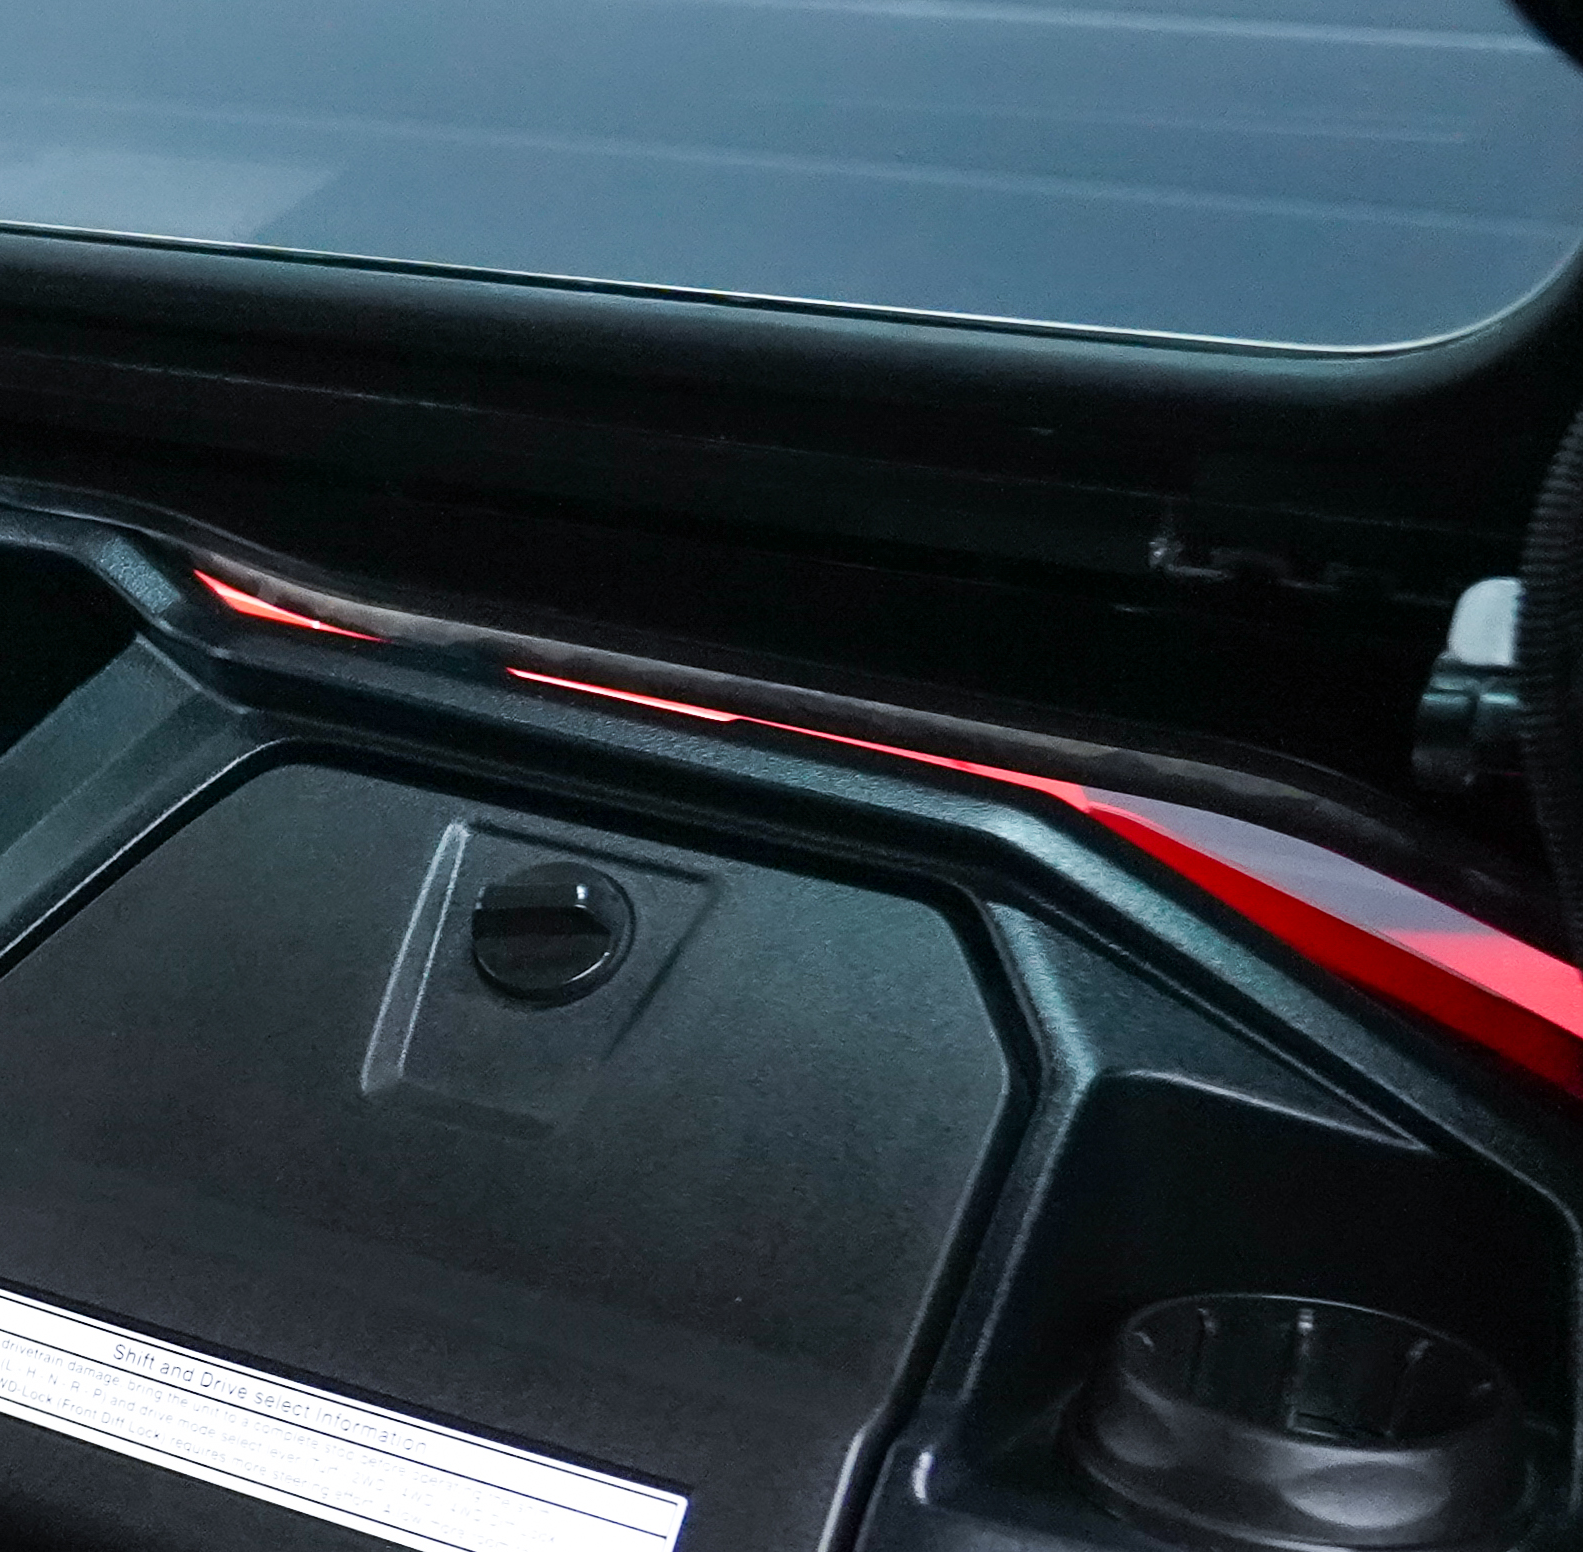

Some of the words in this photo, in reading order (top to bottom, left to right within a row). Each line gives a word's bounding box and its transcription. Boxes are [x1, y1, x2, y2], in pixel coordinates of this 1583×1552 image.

[0, 1338, 63, 1366] drivetrain
[126, 1378, 163, 1403] bring
[166, 1391, 188, 1408] the
[223, 1409, 237, 1424] to
[25, 1365, 37, 1378] H
[47, 1372, 58, 1385] N
[69, 1379, 81, 1392] R
[109, 1395, 136, 1412] and
[138, 1405, 173, 1424] drive
[177, 1417, 216, 1438] mode
[112, 1342, 155, 1370] Shift
[158, 1361, 195, 1382] and
[199, 1370, 247, 1399] Drive
[253, 1391, 310, 1418] select
[315, 1407, 426, 1451] Information
[56, 1397, 97, 1419] (Front
[169, 1436, 226, 1463] requires
